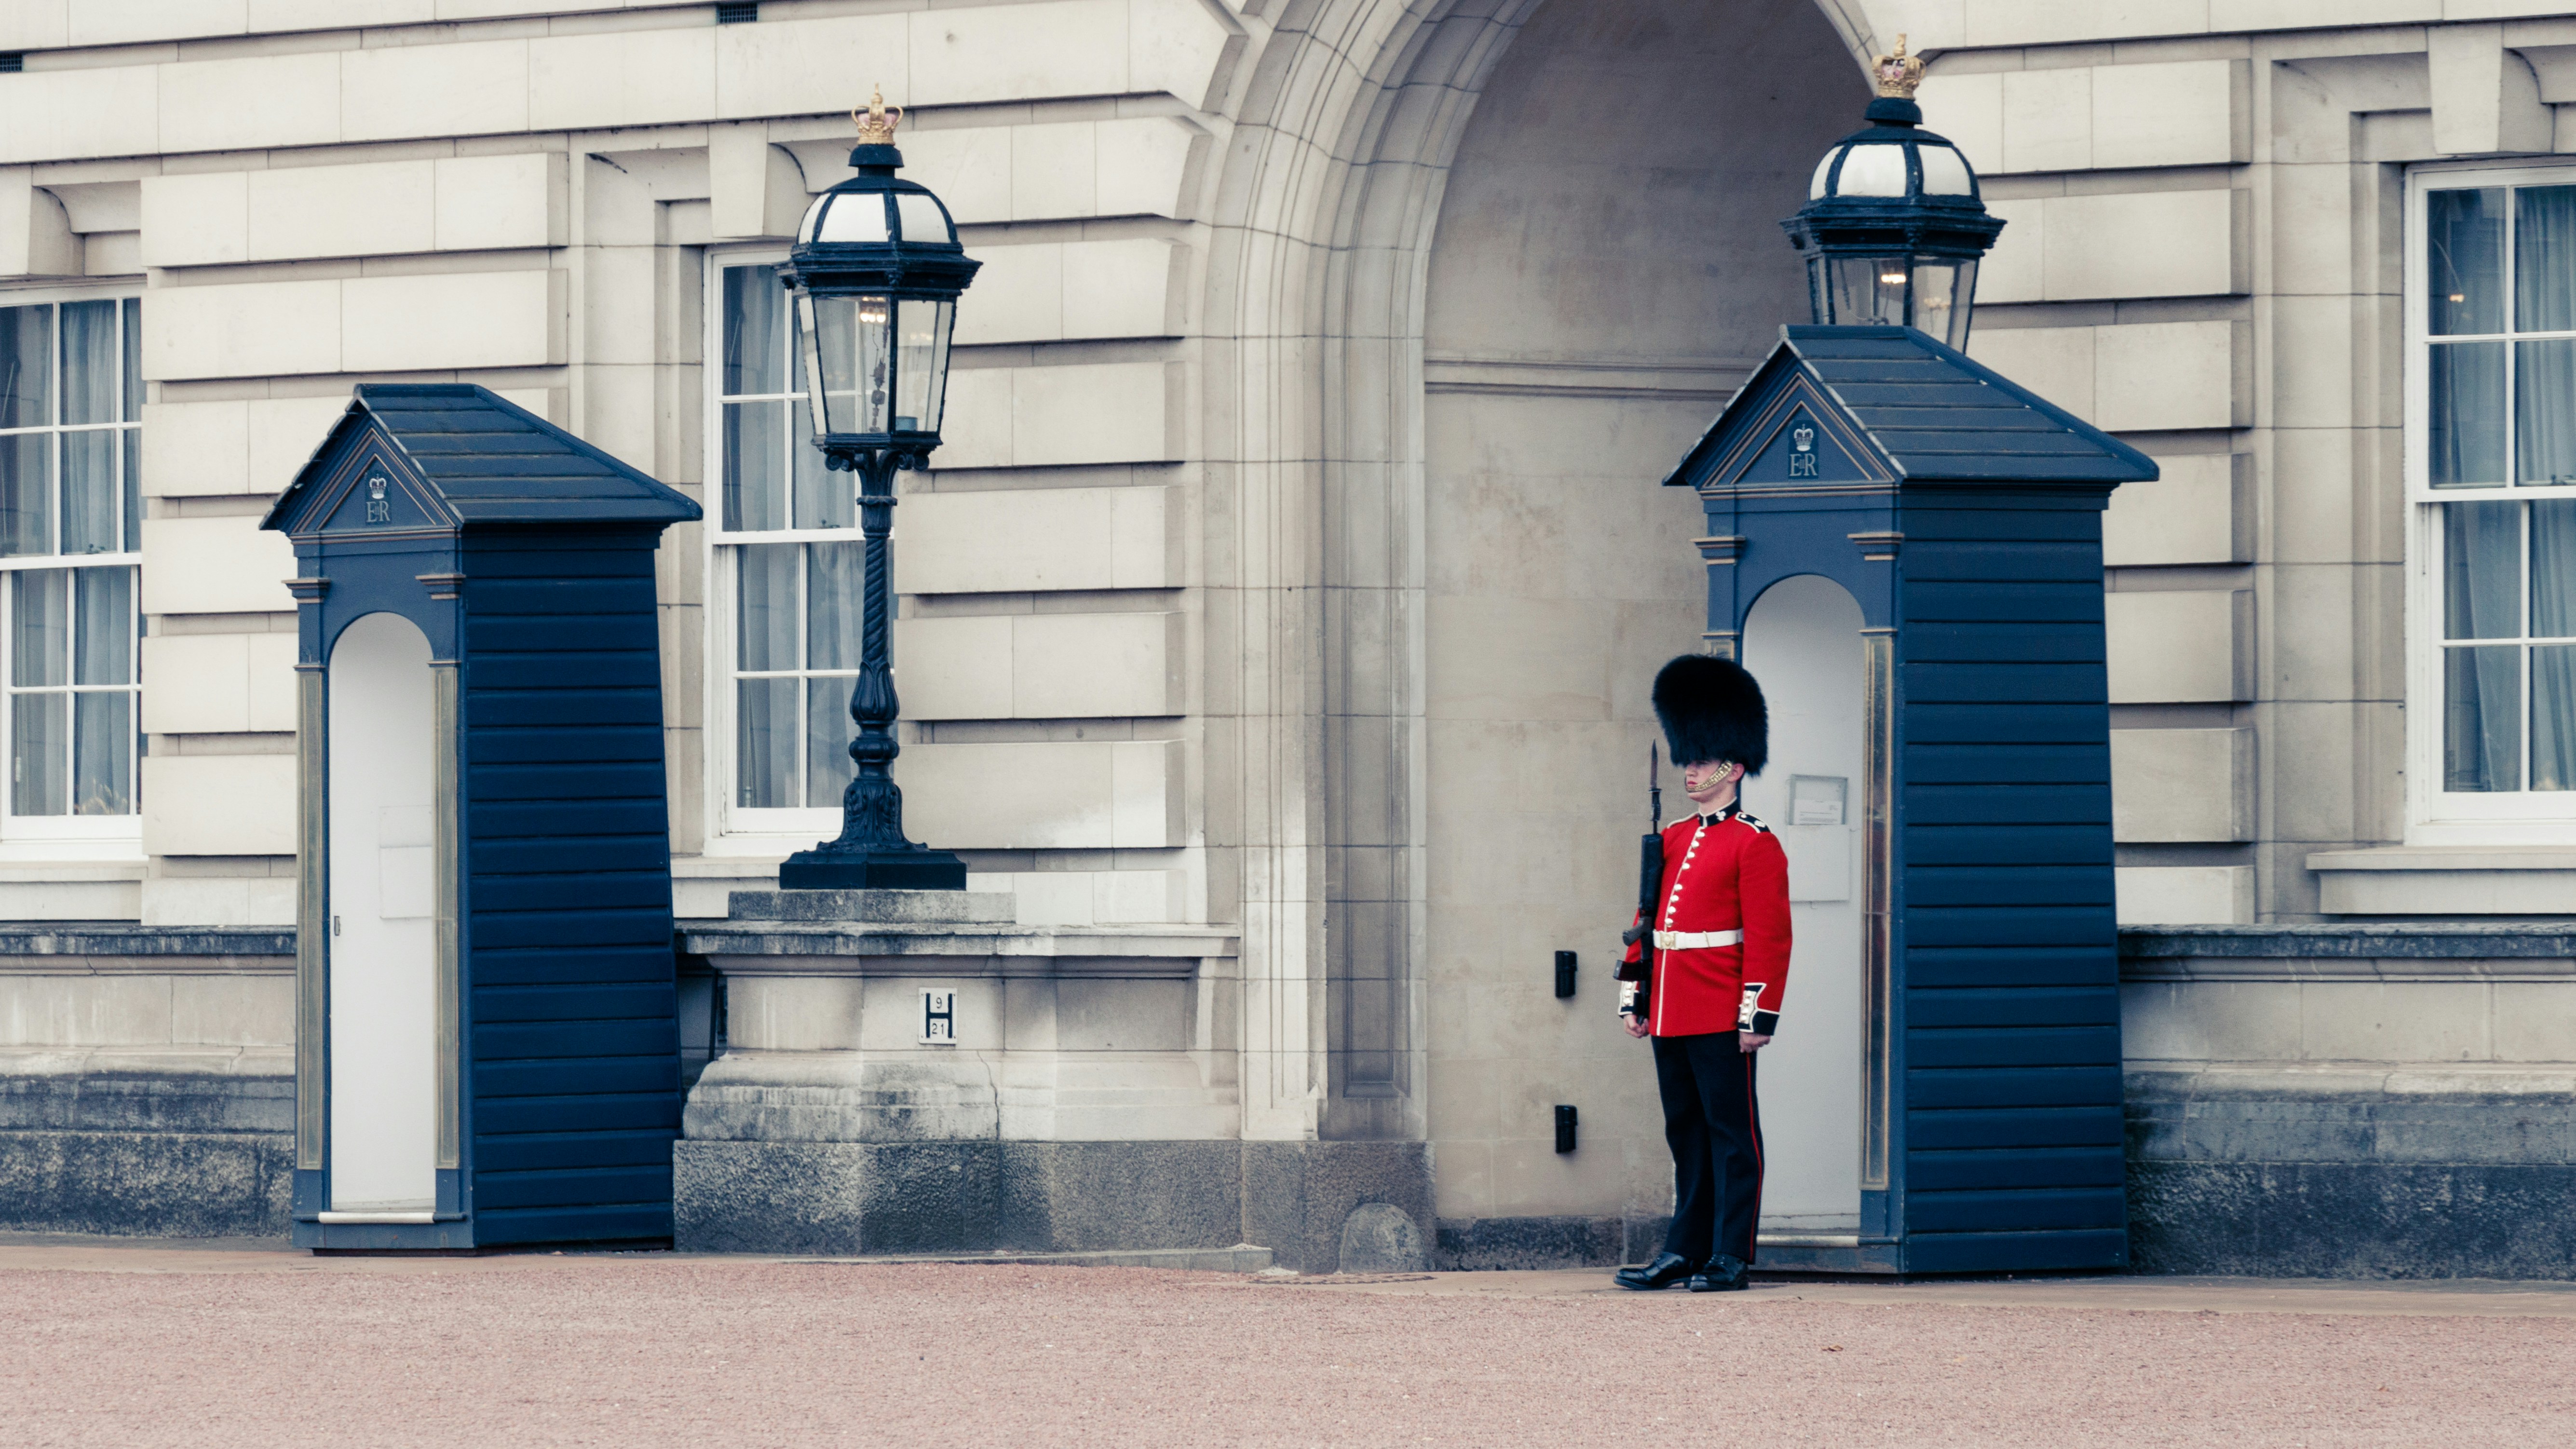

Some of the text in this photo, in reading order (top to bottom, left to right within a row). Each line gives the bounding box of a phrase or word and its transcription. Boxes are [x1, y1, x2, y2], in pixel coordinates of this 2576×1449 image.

[936, 997, 942, 1009] 9
[926, 993, 952, 1038] H
[932, 1023, 944, 1034] 21
